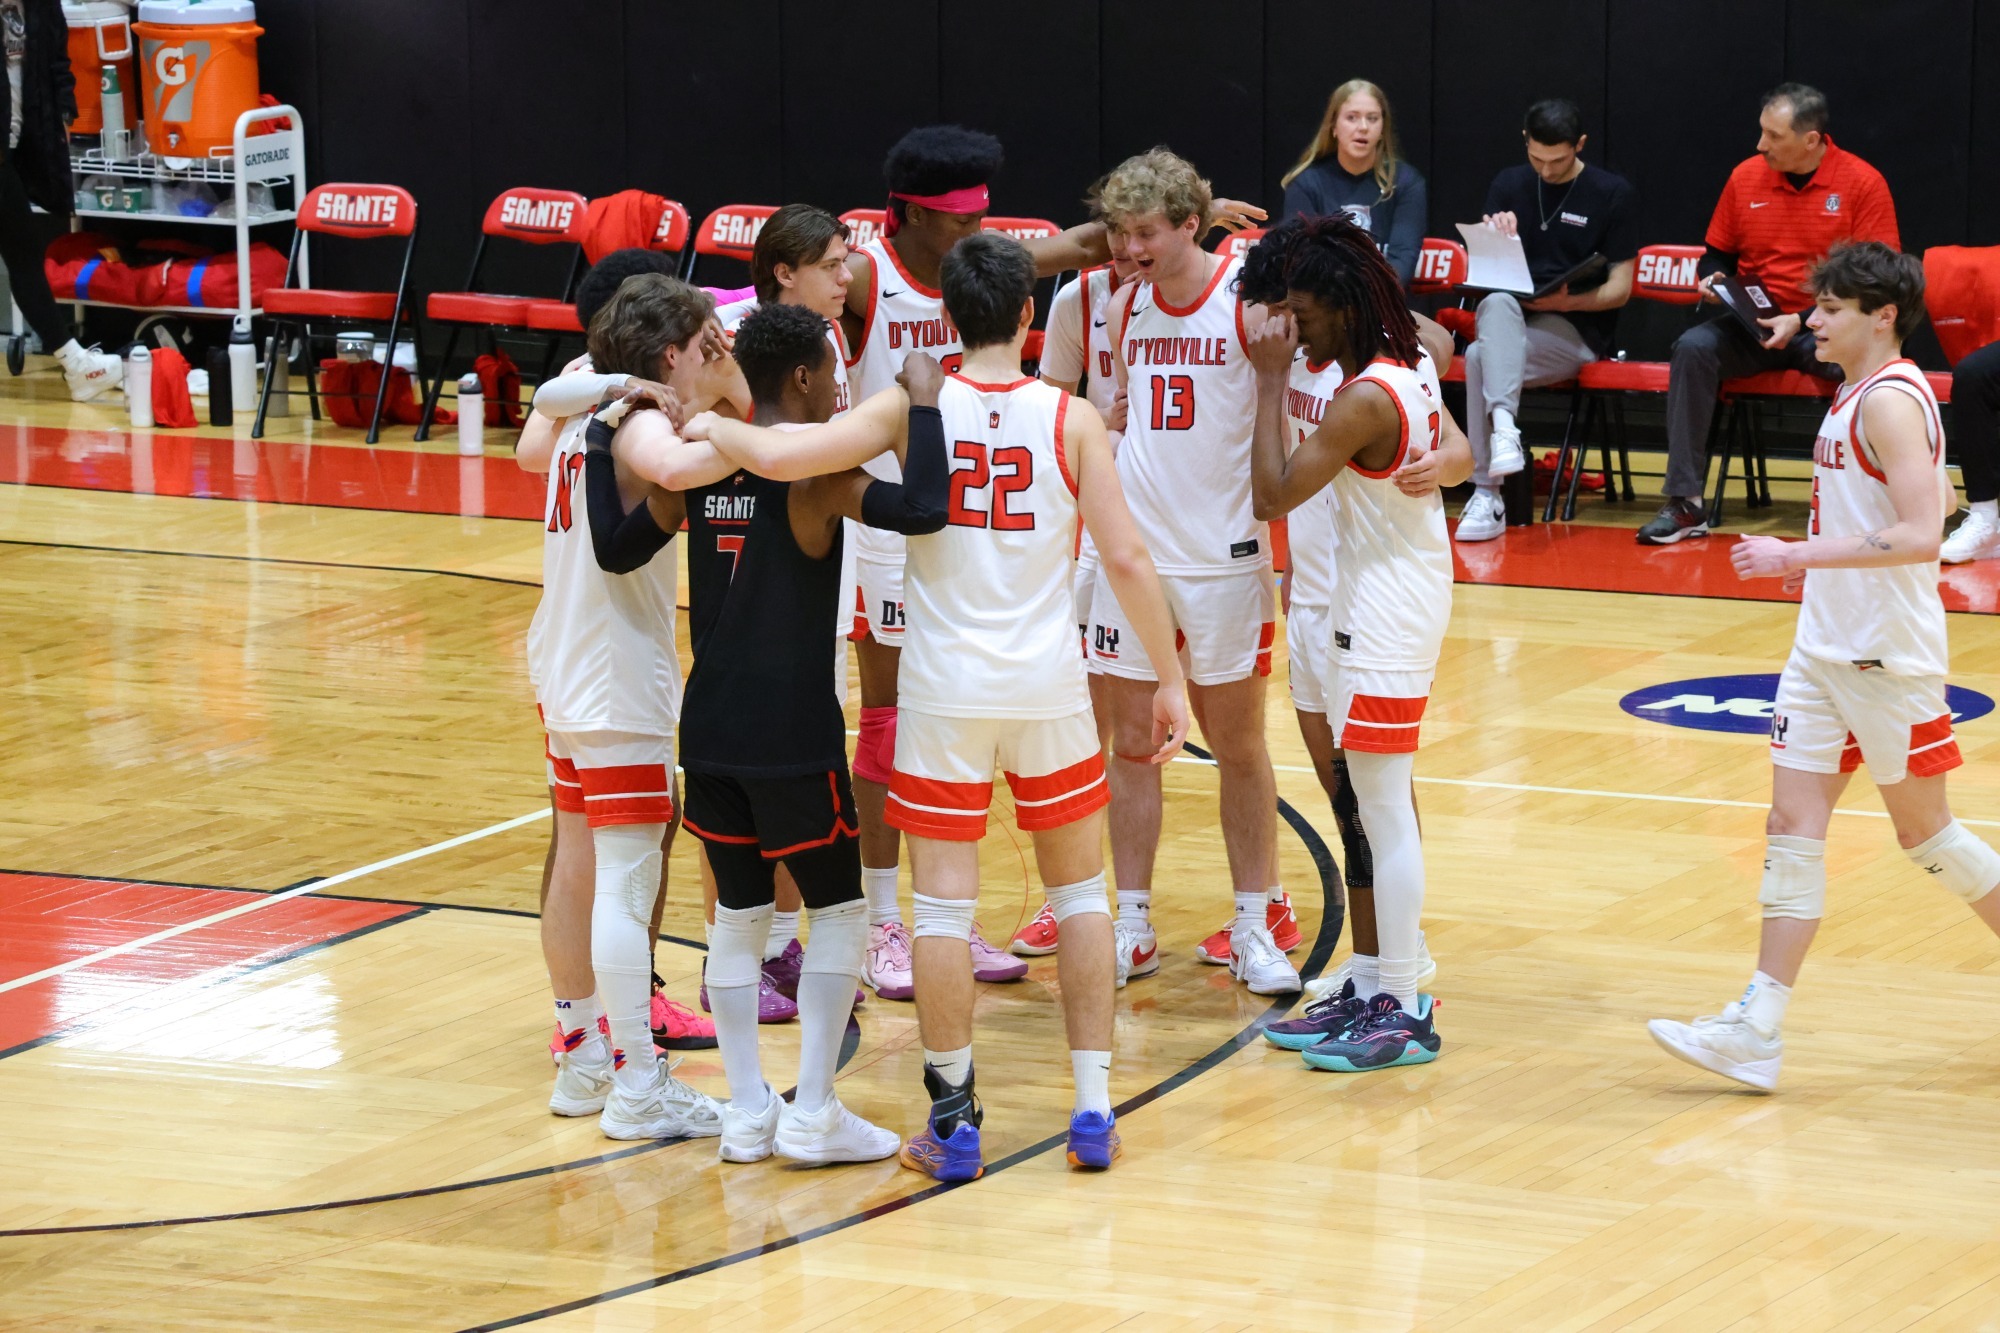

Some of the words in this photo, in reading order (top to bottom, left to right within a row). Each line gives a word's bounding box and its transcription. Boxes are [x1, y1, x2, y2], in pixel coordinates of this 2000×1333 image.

[156, 47, 187, 86] G
[245, 147, 290, 167] GATORADE
[1127, 337, 1227, 367] D'YOUVILLE
[1150, 374, 1195, 431] 13
[947, 440, 1035, 531] 22
[717, 534, 746, 587] 7
[555, 1001, 572, 1009] SA
